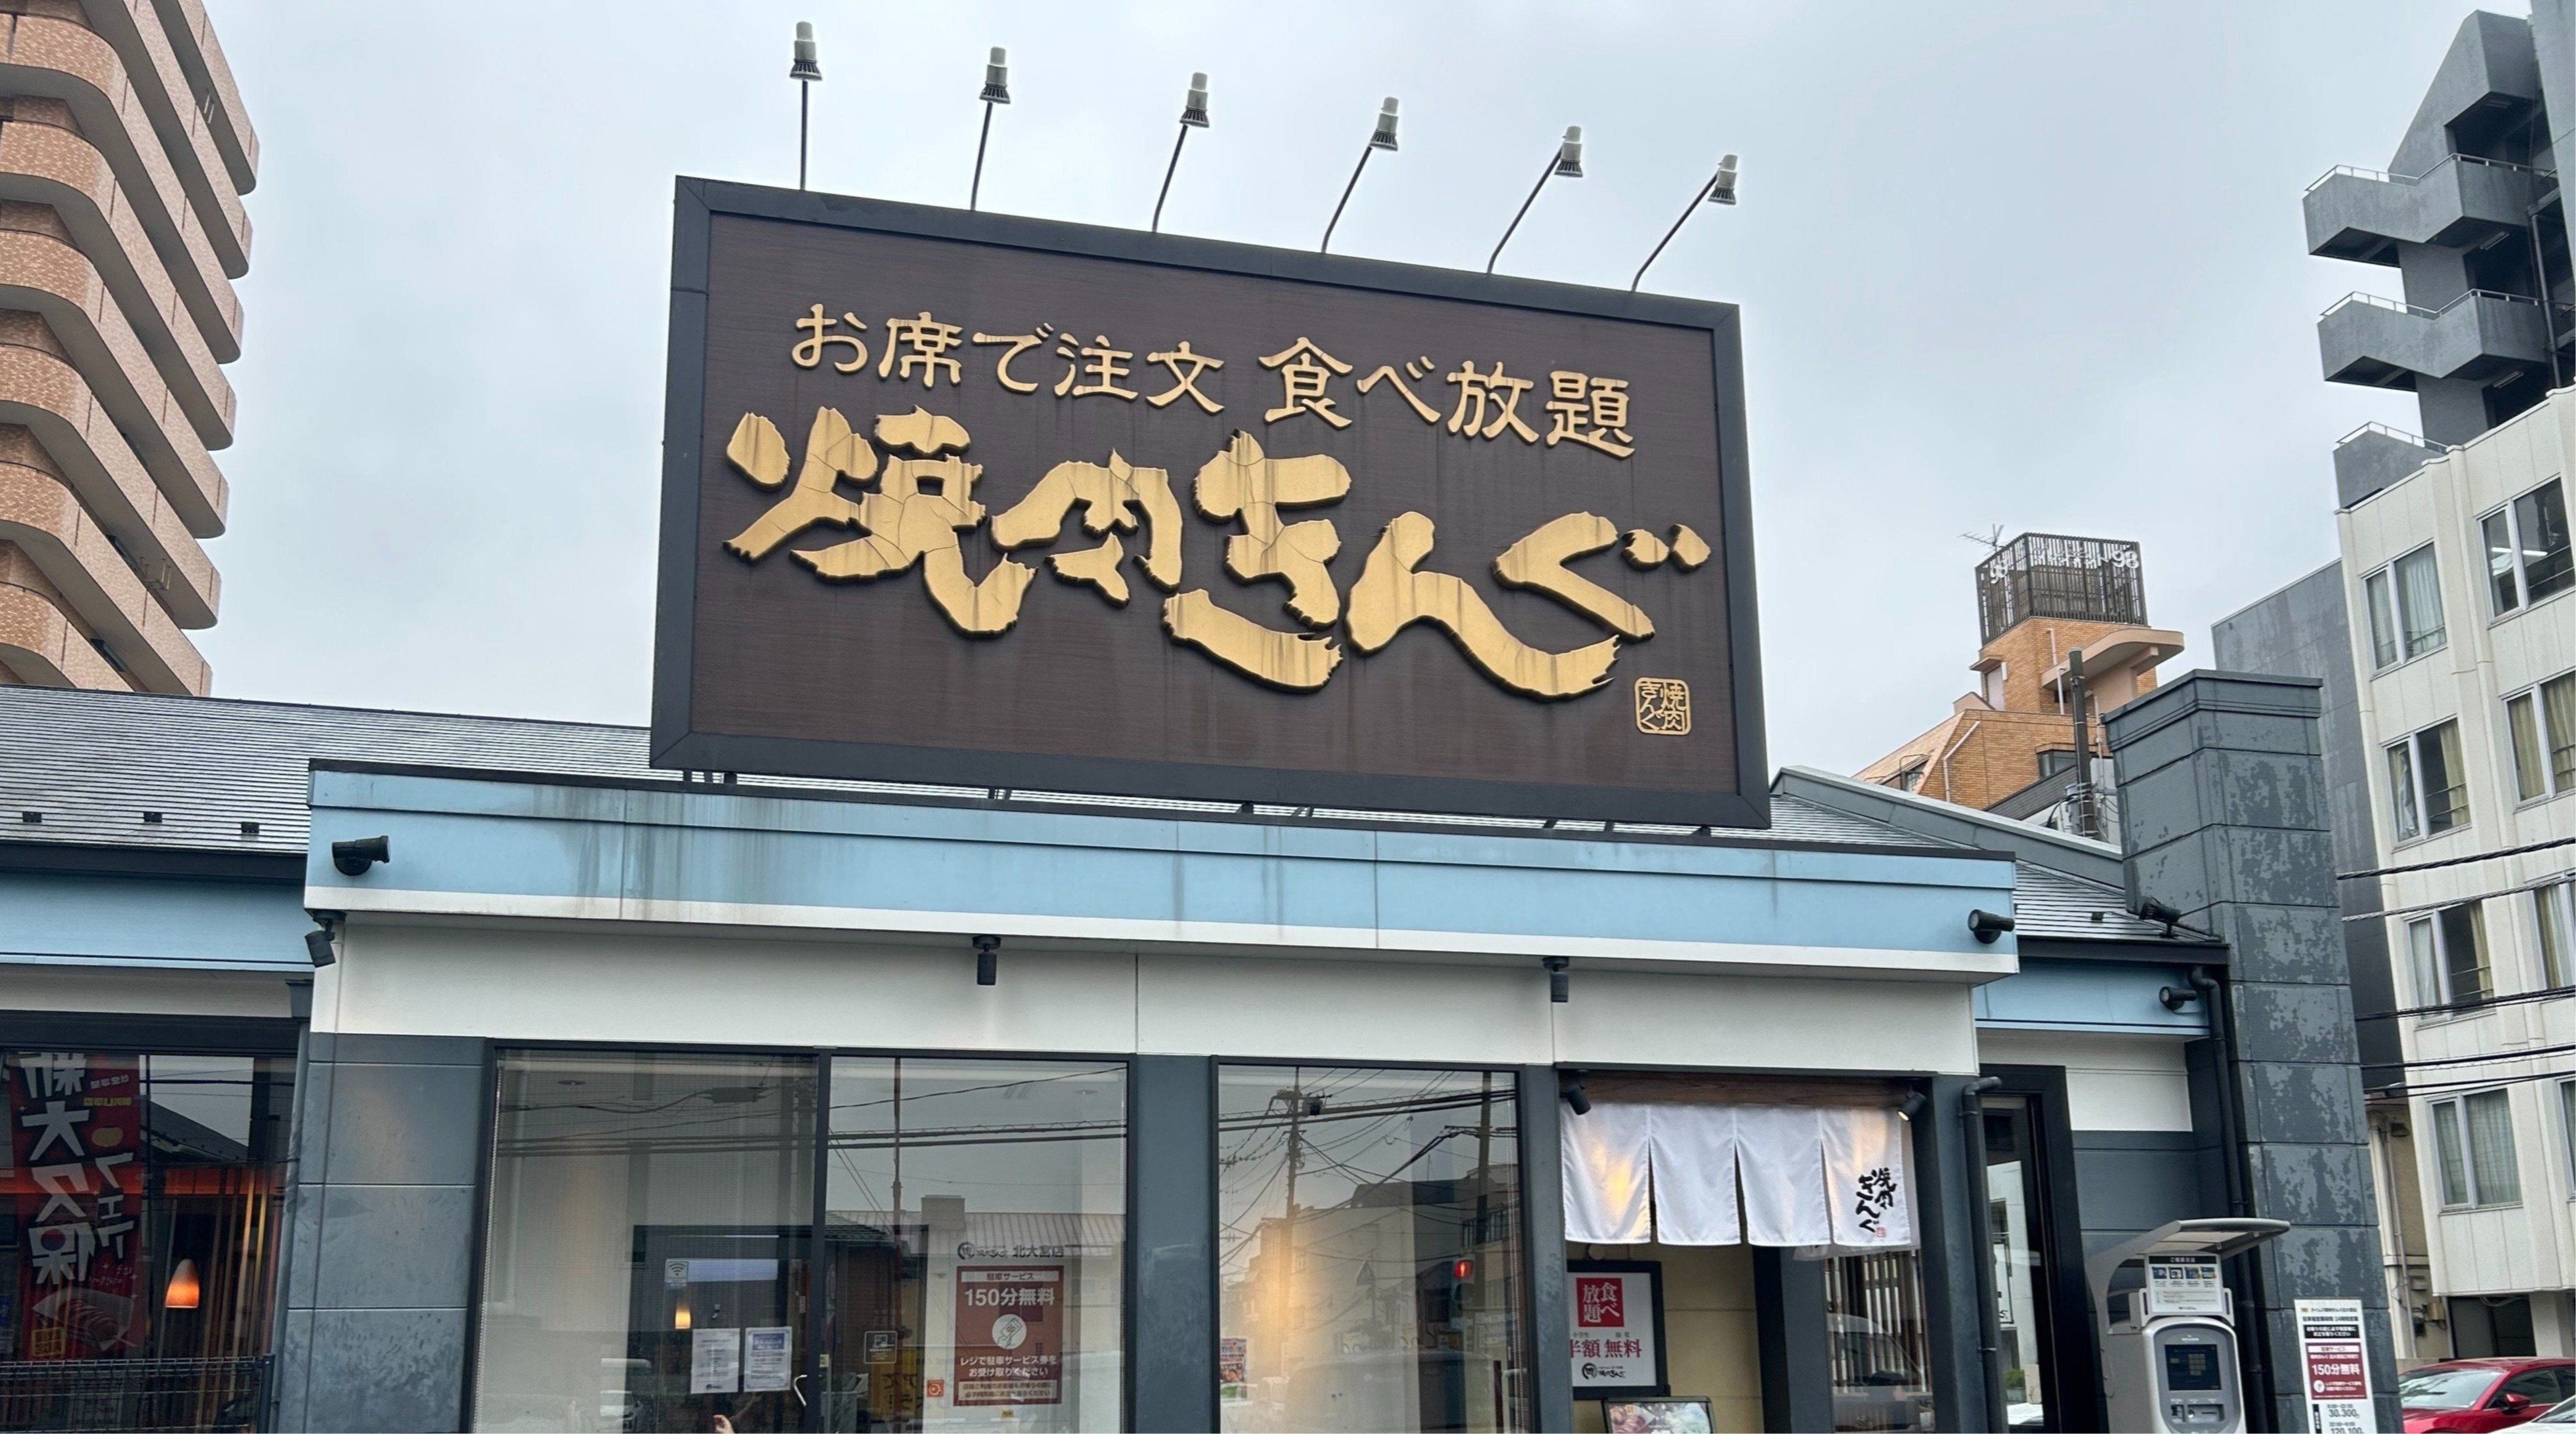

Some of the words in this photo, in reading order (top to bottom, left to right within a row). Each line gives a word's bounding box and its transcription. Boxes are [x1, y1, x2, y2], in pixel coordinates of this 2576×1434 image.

[790, 302, 1226, 414] お席で注文
[1258, 337, 1636, 459] 食べ放題
[723, 403, 1711, 704] 焼肉きんぐ
[1013, 1245, 1065, 1258] 北大宮店
[965, 1287, 1055, 1306] 150分無料
[1583, 1284, 1601, 1323] 放題
[1601, 1282, 1620, 1318] 食べ
[1605, 1339, 1642, 1358] 無料
[960, 1355, 1057, 1366] レジで駐車サービス券を
[2312, 1364, 2361, 1375] 150分無料
[969, 1367, 1049, 1378] お受け取りください
